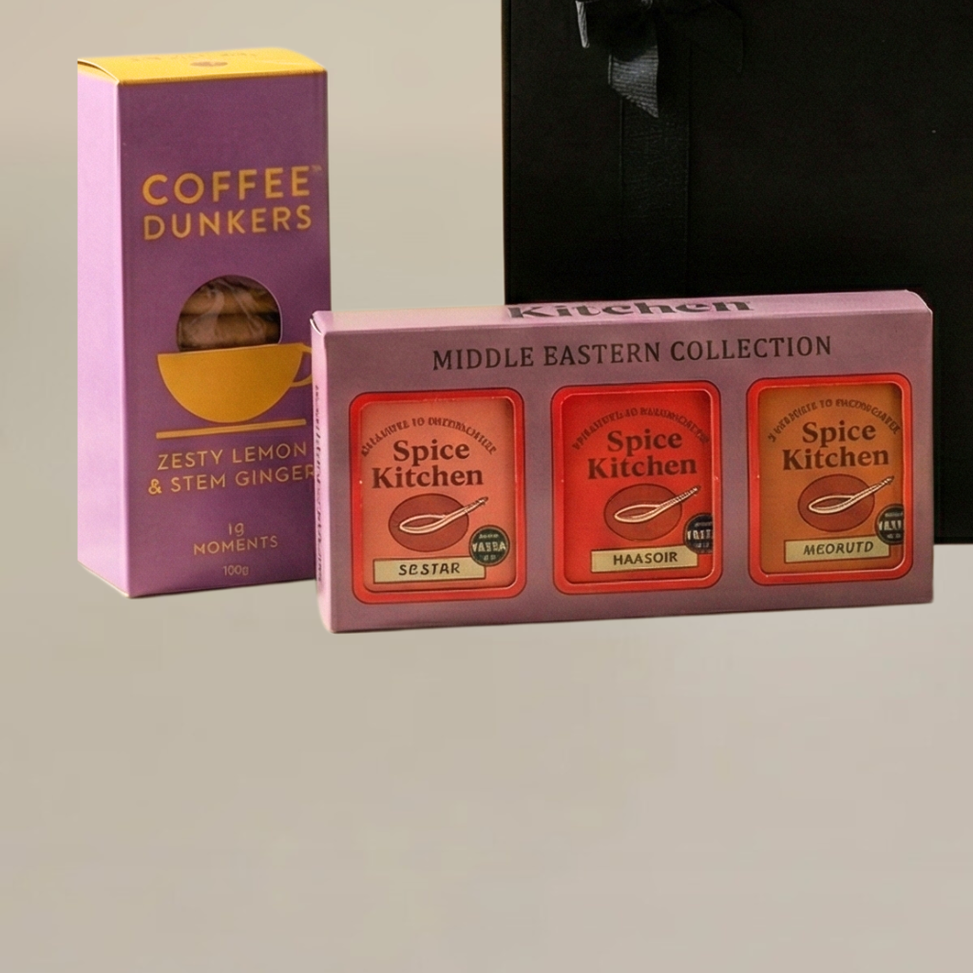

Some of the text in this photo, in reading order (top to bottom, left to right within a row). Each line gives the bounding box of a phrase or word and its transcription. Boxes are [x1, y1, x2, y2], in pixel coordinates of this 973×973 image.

[142, 165, 310, 206] COFFEE
[143, 204, 312, 241] DUNKERS
[506, 300, 755, 318] Kitchen
[432, 335, 832, 371] MIDDLE EASTERN COLLECTION
[607, 428, 683, 457] Spice
[802, 419, 876, 448] Spice
[157, 441, 307, 471] ZESTY LEMON
[392, 438, 470, 467] Spice
[782, 446, 889, 471] Kitchen
[148, 464, 315, 495] & STEM GINGER
[371, 464, 484, 489] Kitchen
[587, 455, 697, 480] Kitchen
[613, 551, 678, 566] HAASOIR
